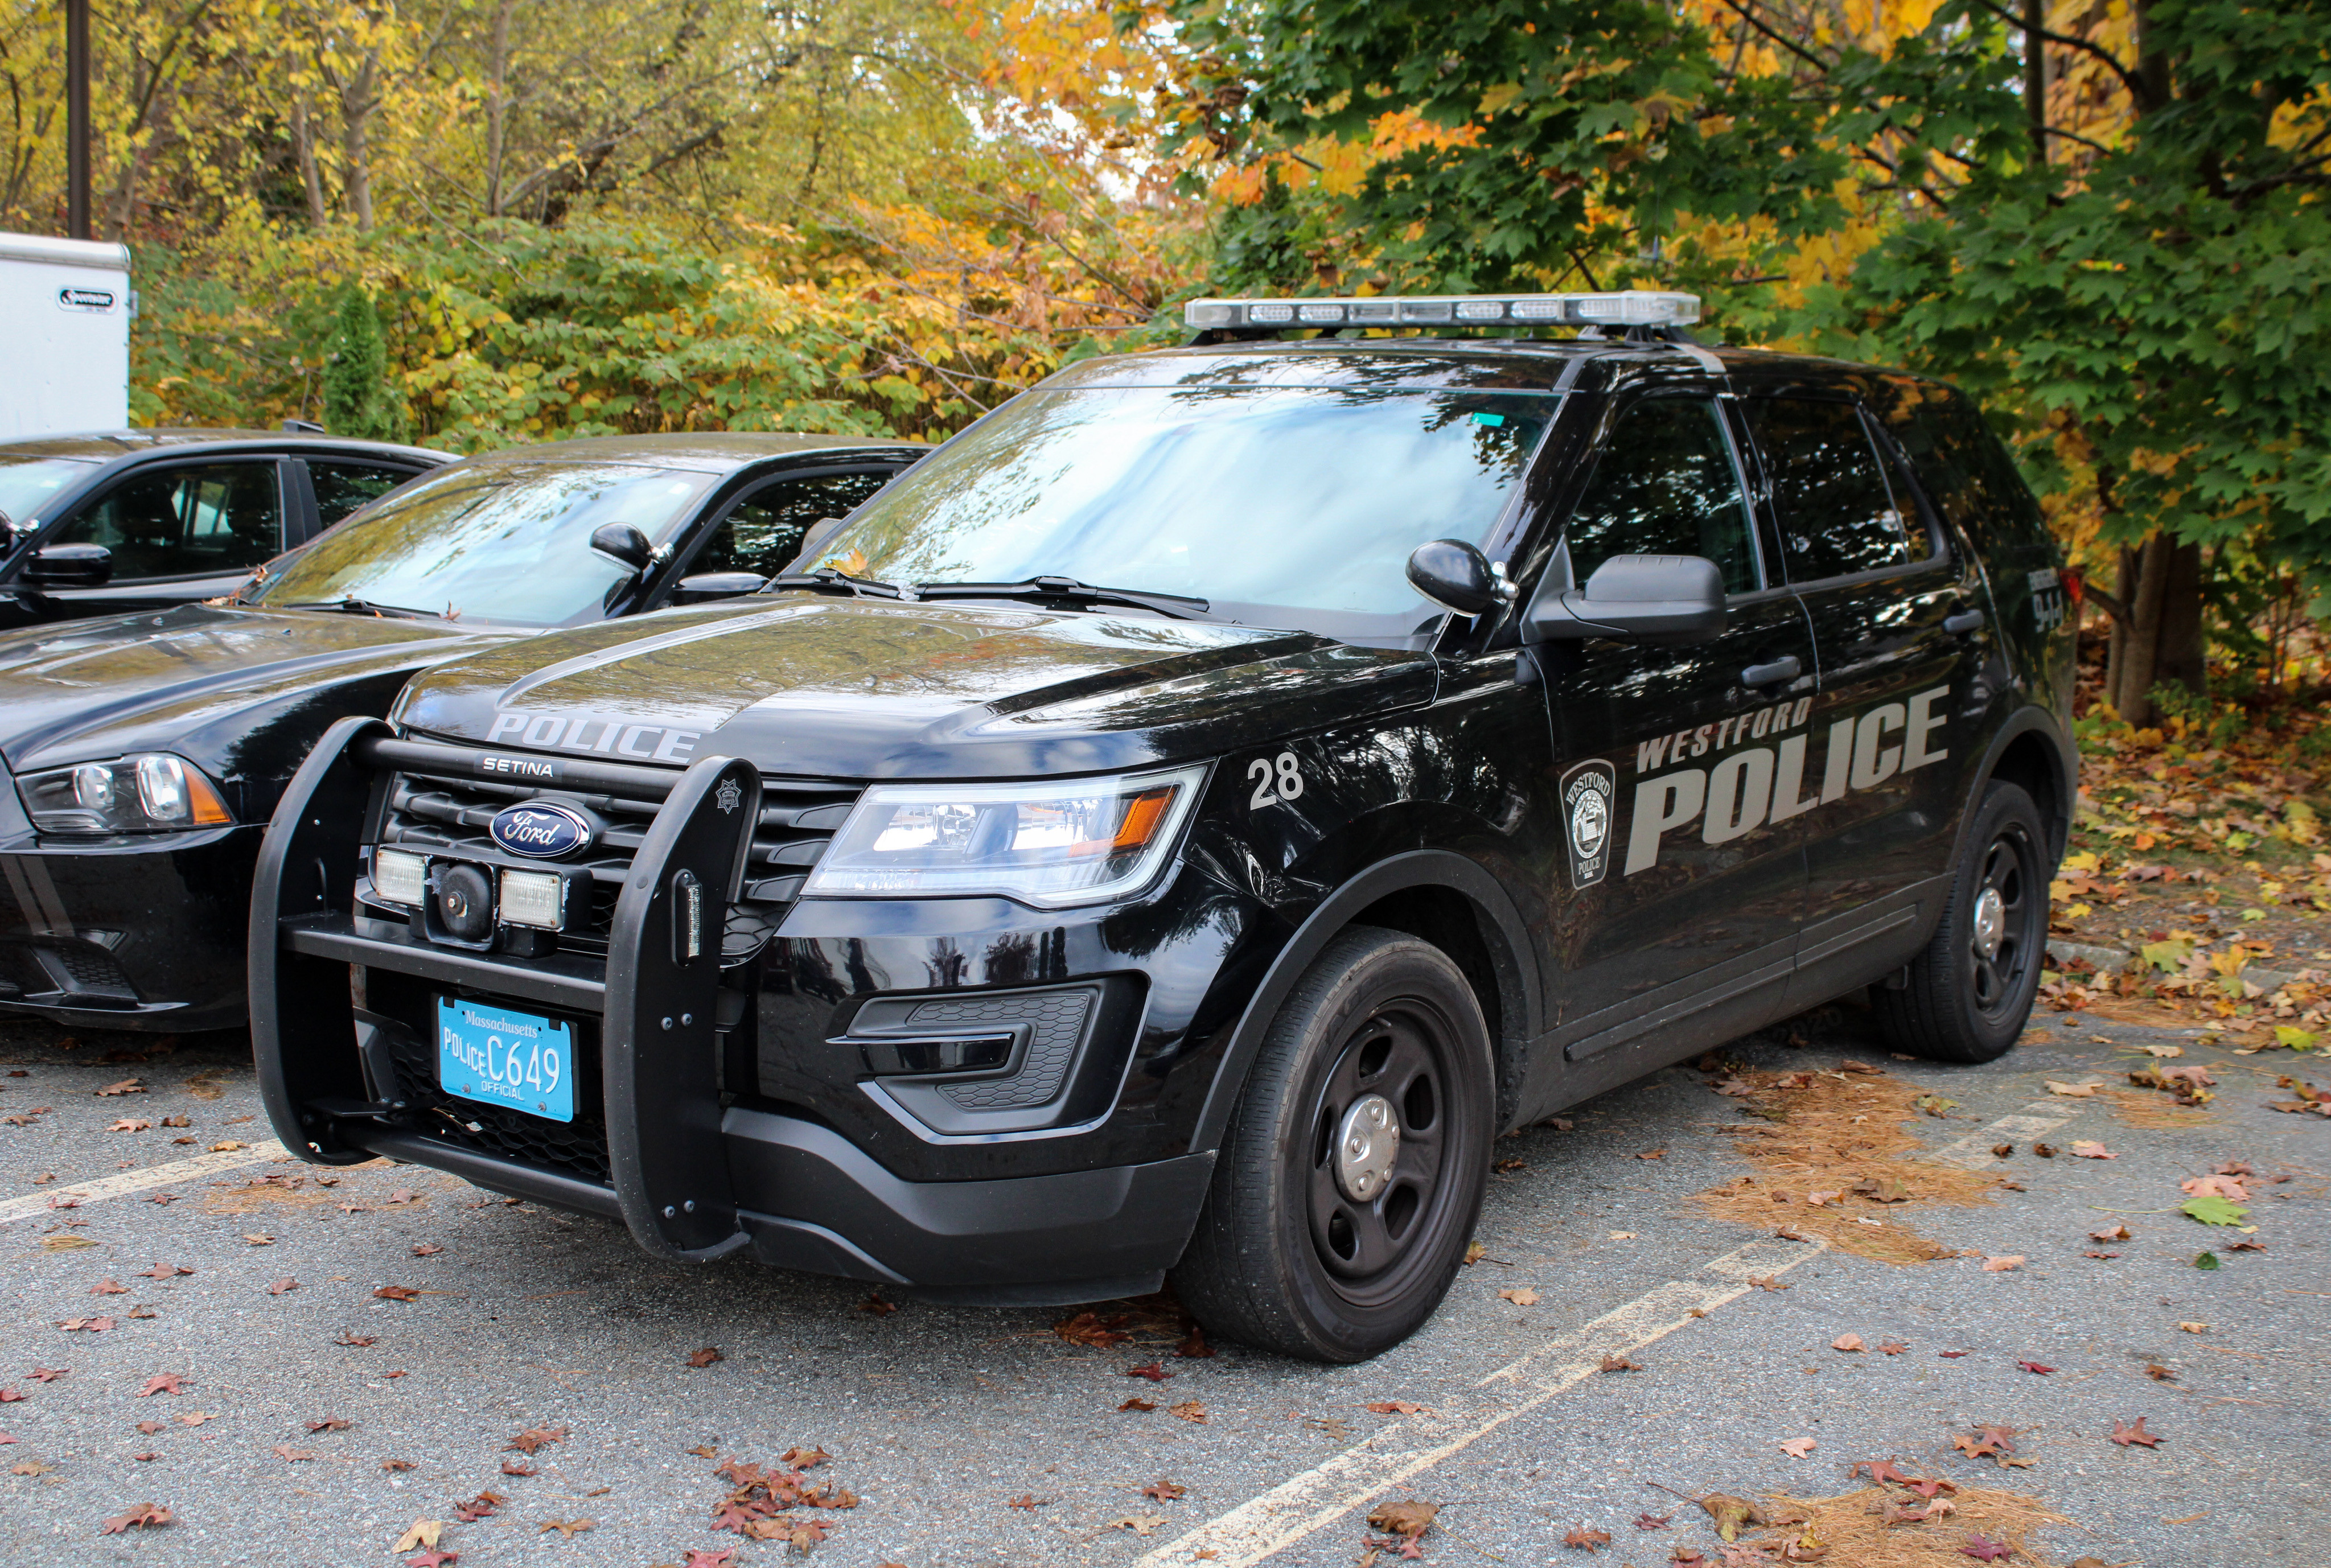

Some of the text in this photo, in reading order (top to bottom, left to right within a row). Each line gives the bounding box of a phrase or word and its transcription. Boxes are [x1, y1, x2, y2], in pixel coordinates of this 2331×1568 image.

[486, 714, 700, 763] POLICE
[1637, 697, 1812, 773] WESTFORD
[483, 758, 553, 777] SETINA
[1248, 752, 1304, 810] 28
[1623, 685, 1950, 876] POLICE
[1566, 772, 1610, 805] WESTFORD
[505, 811, 561, 846] Ford
[1578, 857, 1600, 875] POLICE
[466, 1010, 537, 1038] Massachusetts
[444, 1027, 560, 1093] POLICE C649
[482, 1081, 524, 1101] OFFICIAL
